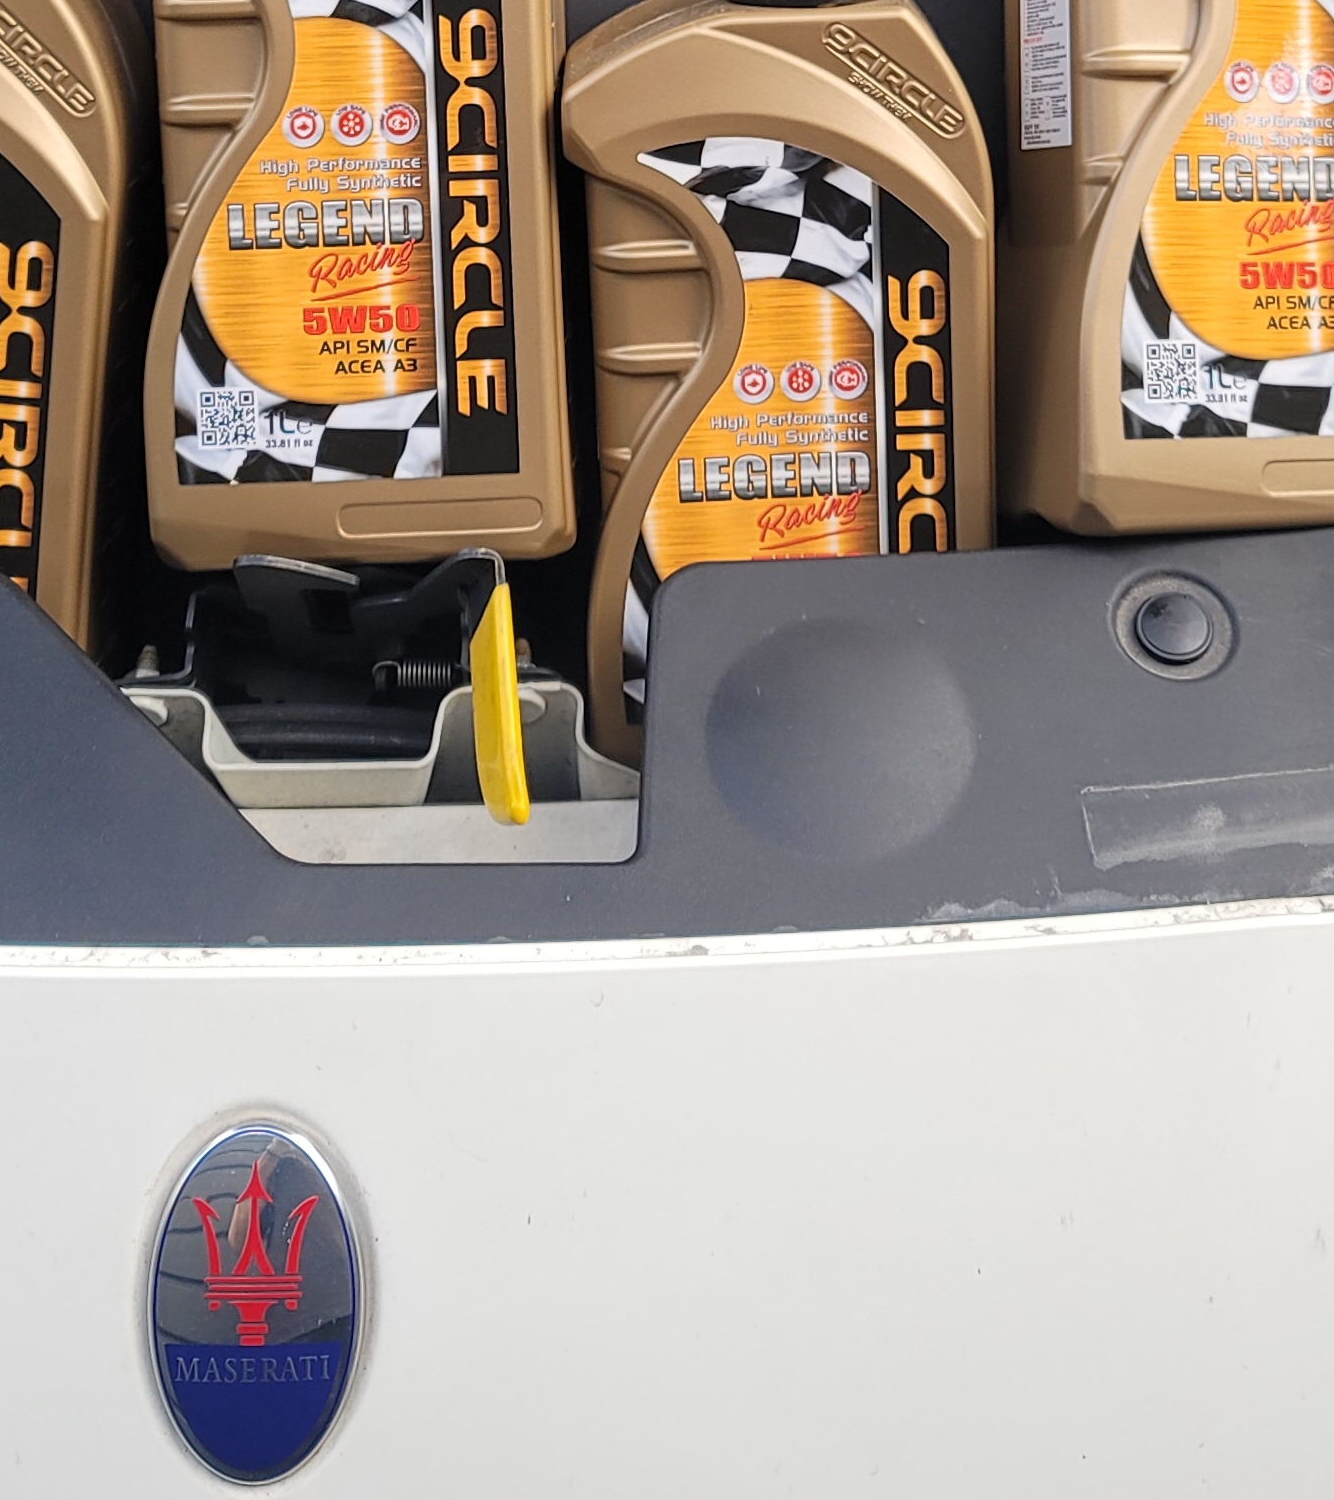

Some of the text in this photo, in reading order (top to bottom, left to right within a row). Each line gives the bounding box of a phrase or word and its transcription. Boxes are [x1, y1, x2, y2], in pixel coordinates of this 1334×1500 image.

[1203, 112, 1237, 131] High
[259, 156, 421, 177] High Performance
[286, 173, 422, 194] Fully Synthetic
[438, 7, 508, 417] 9CIRCLE
[227, 198, 425, 250] LEGEND
[308, 238, 417, 293] Racing
[1253, 296, 1280, 310] API
[302, 303, 421, 336] 5W50
[1266, 315, 1311, 330] ACEA
[319, 337, 418, 356] API SM/CF
[334, 358, 418, 375] ACEA A3
[710, 411, 869, 431] High Performance
[887, 269, 948, 555] 9CIRC
[265, 439, 292, 449] 33.81
[736, 428, 869, 446] Fully Synthetic
[677, 451, 871, 504] LEGEND
[757, 489, 863, 542] Racing
[174, 1355, 331, 1383] MASERATI
